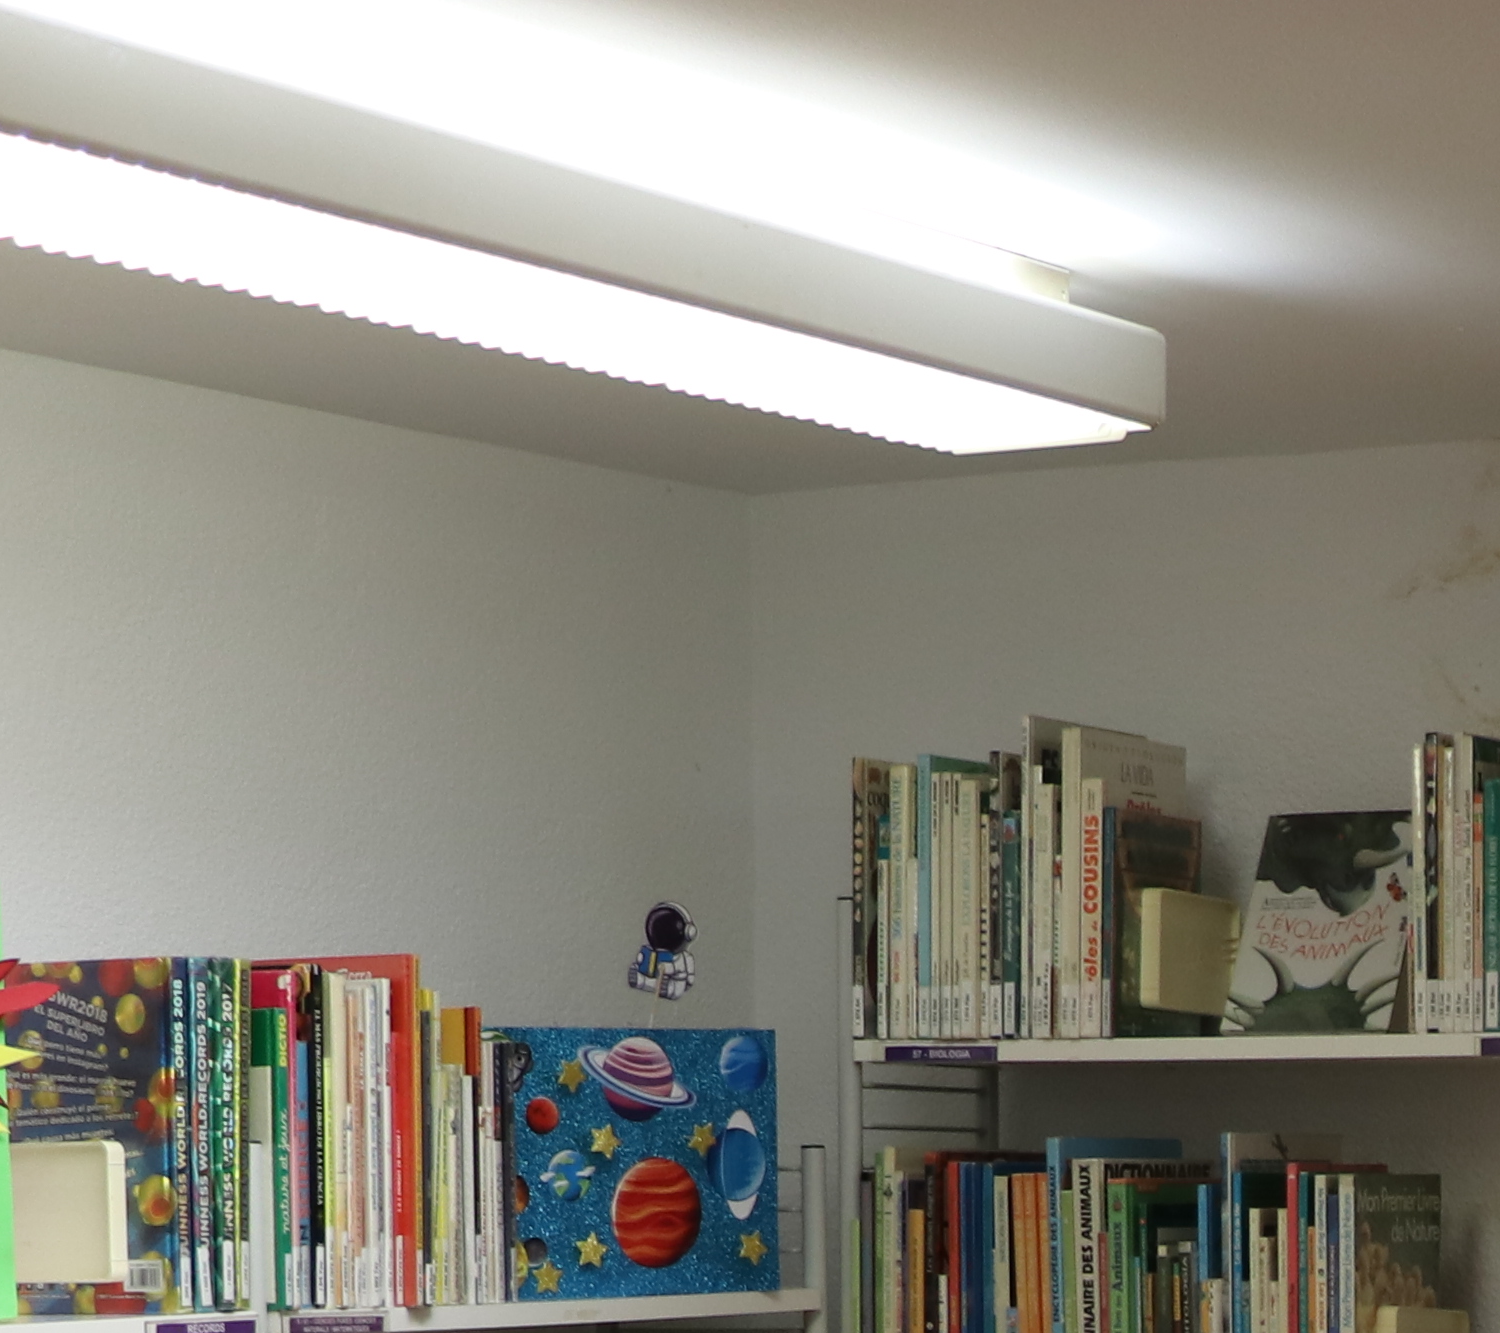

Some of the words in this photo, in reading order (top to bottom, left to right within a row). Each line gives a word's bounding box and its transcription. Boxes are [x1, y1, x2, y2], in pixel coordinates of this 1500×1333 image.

[1083, 815, 1099, 914] COUSINS
[1257, 903, 1391, 940] L'ÉVOLUTION
[1259, 933, 1288, 953] DES
[1290, 925, 1388, 960] ANIMAUX
[171, 978, 183, 1017] 2018
[192, 981, 206, 1019] 2019
[215, 982, 231, 1022] 2017
[46, 1006, 106, 1038] SUPERLIBRO
[46, 1019, 64, 1035] DEL
[65, 1025, 89, 1043] AÑO
[277, 1014, 288, 1068] DICTIO
[193, 1023, 210, 1106] RECORDS
[928, 1049, 972, 1060] BIOLOGIA
[174, 1104, 190, 1170] WORLD
[194, 1107, 211, 1171] WORLD
[280, 1176, 292, 1235] nature
[1078, 1165, 1092, 1239] ANIMAUX
[1080, 1246, 1094, 1274] DES
[1111, 1223, 1124, 1291] Animaux
